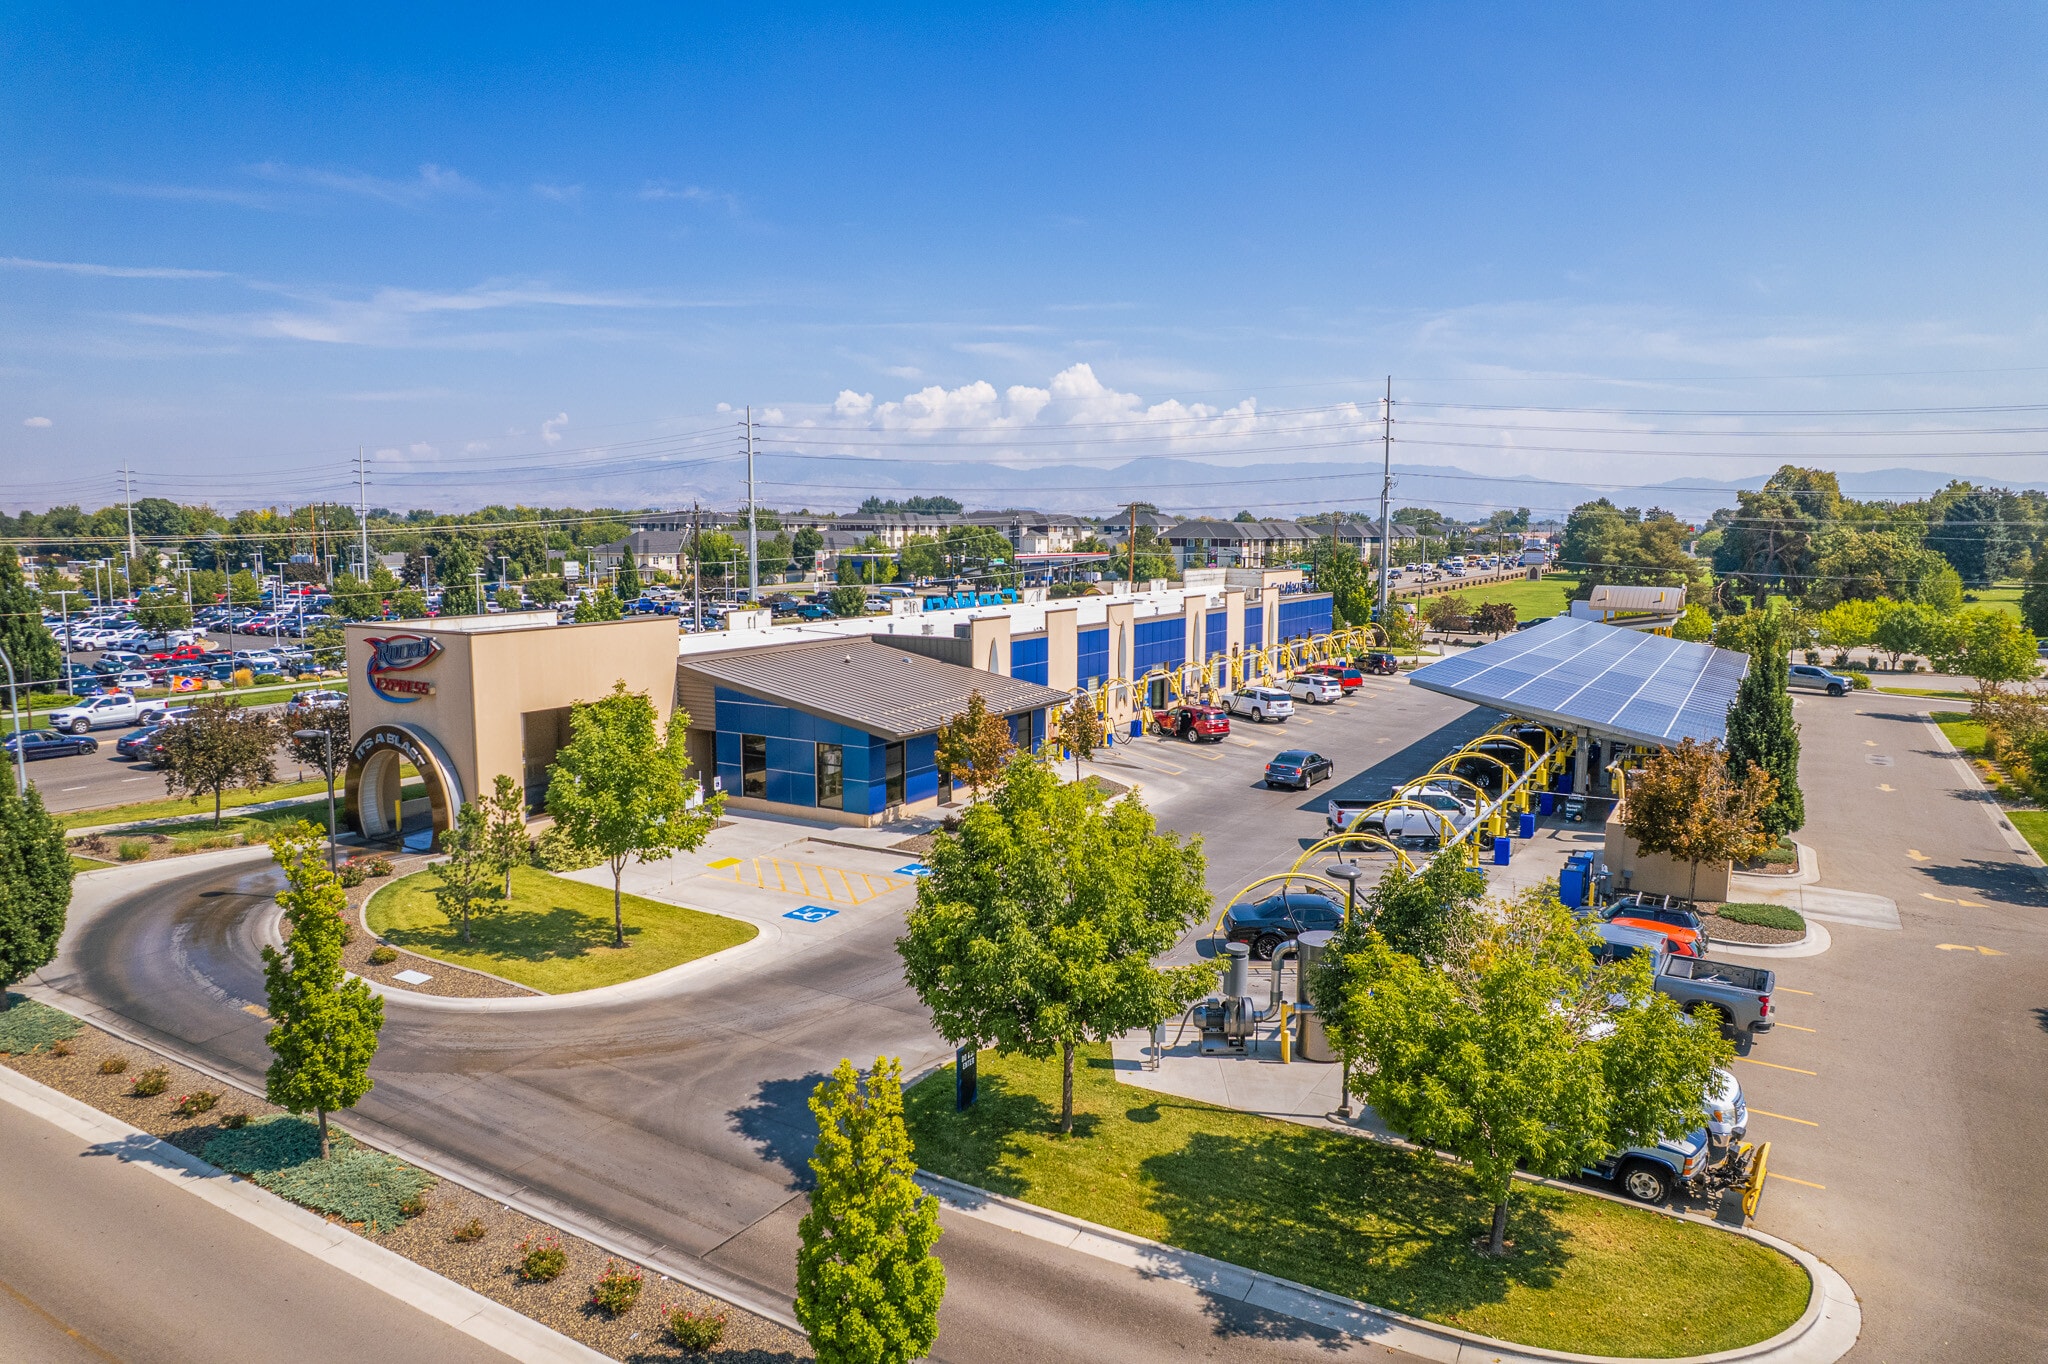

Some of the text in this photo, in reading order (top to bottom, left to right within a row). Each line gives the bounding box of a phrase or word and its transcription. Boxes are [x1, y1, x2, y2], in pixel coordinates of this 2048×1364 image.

[376, 678, 430, 695] EXPRESS
[375, 733, 386, 744] A
[386, 732, 426, 766] BLAST
